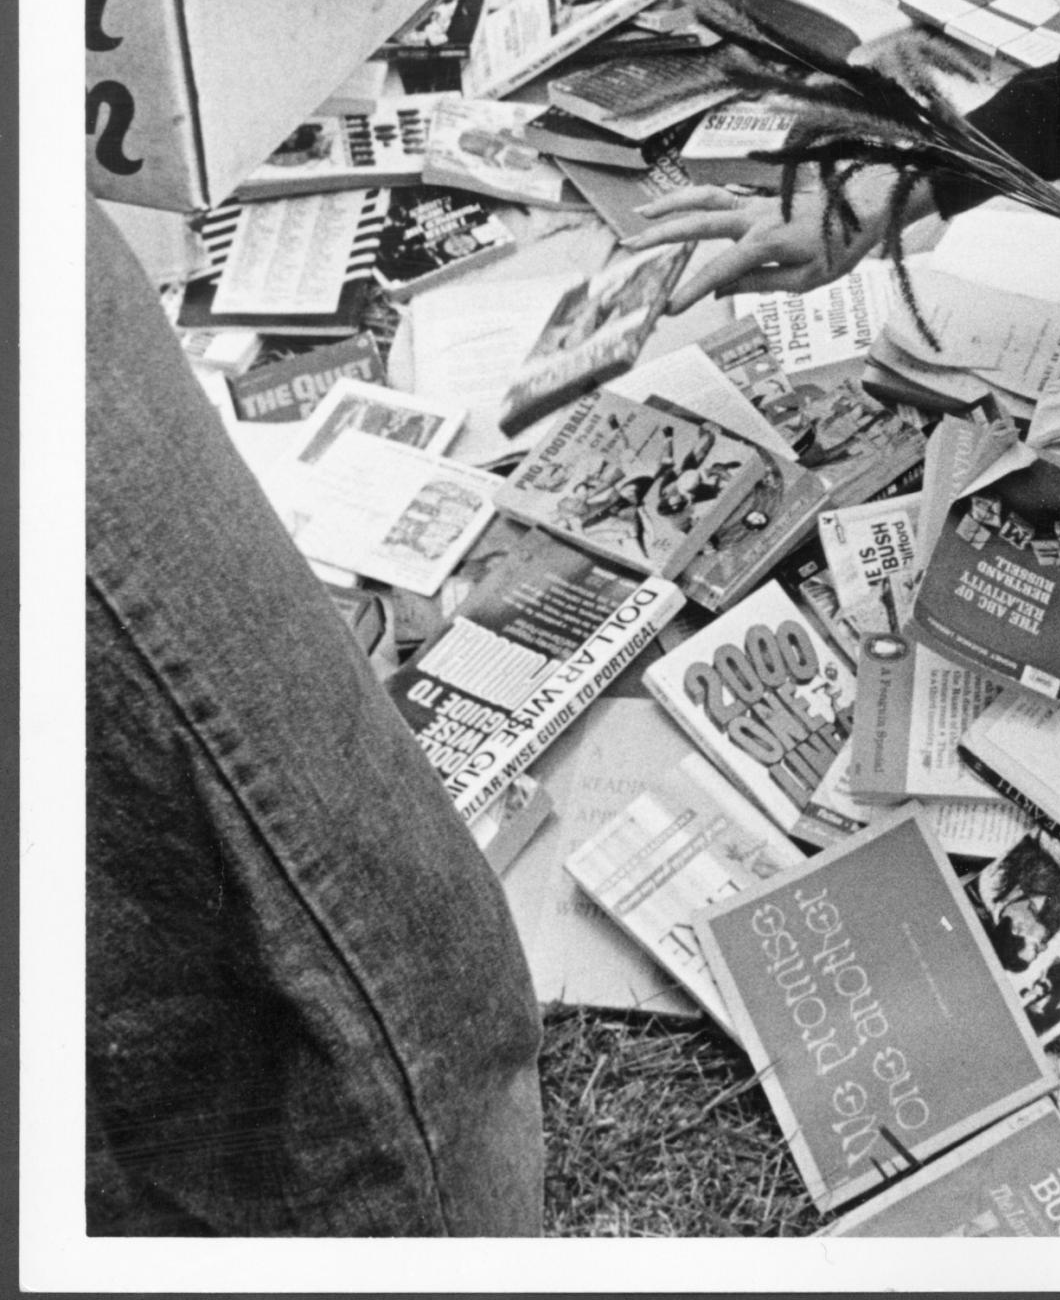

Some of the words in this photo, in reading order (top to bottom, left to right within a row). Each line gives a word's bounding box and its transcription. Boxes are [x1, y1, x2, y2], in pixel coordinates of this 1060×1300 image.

[757, 300, 784, 364] ortrait
[826, 285, 849, 340] William
[245, 383, 290, 420] THE
[515, 461, 543, 493] PRO
[953, 584, 976, 600] OF
[958, 571, 1047, 622] RELATIVITY
[976, 560, 1052, 606] BERTRAND
[994, 554, 1056, 594] RUSSELL
[976, 595, 1008, 620] ABC
[1008, 611, 1041, 636] THE
[557, 588, 659, 685] DOLLAR
[406, 678, 444, 708] TO
[536, 708, 578, 745] GUIDE
[575, 686, 595, 706] TO
[591, 622, 659, 685] PORTUGAL
[684, 619, 820, 734] 2000
[421, 713, 485, 756] WISE
[434, 691, 507, 734] GUIDE
[447, 751, 497, 799] GUI
[752, 903, 857, 1075] promise
[794, 887, 890, 1046] another
[873, 1046, 929, 1130] one
